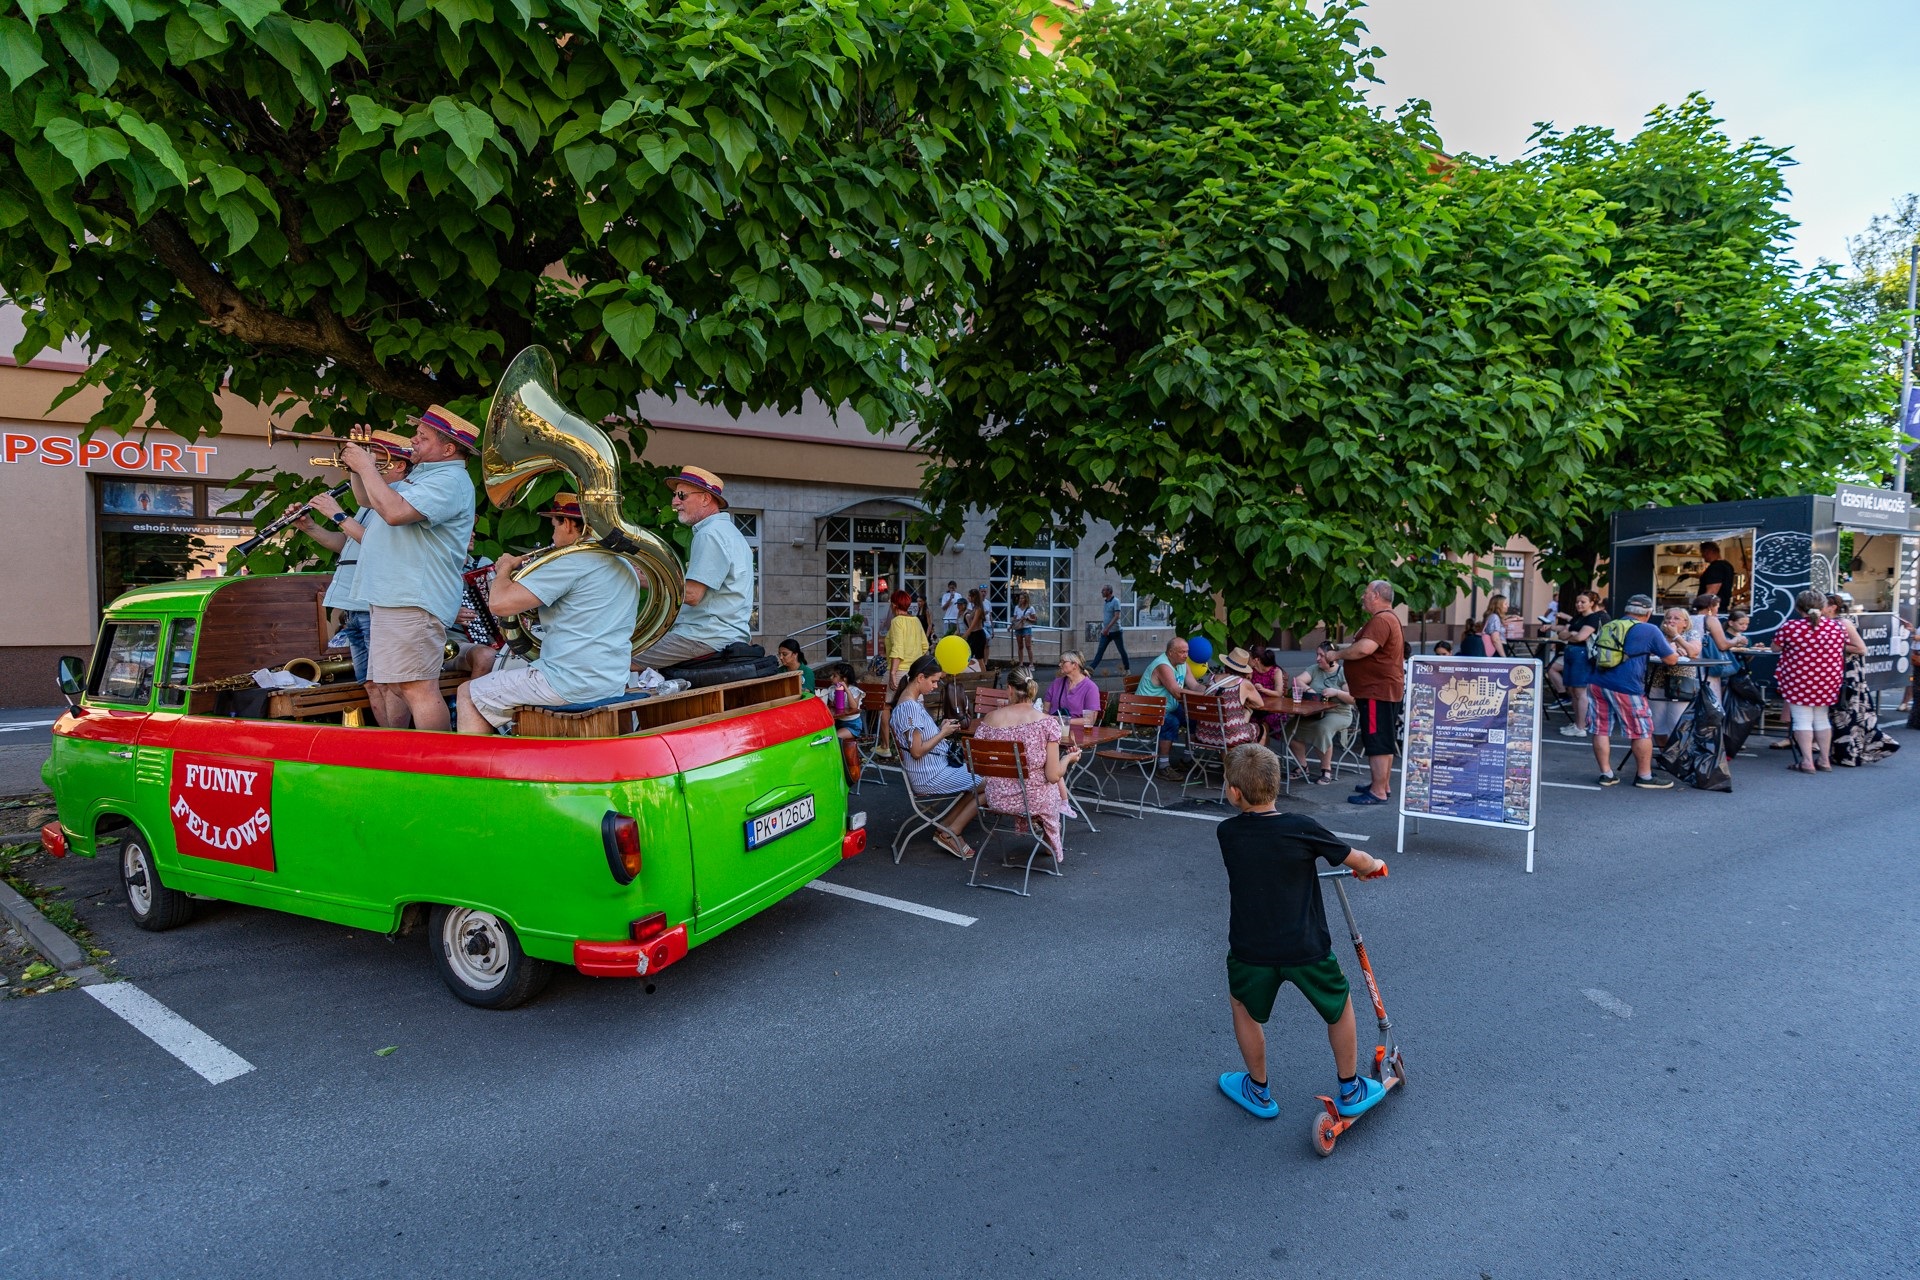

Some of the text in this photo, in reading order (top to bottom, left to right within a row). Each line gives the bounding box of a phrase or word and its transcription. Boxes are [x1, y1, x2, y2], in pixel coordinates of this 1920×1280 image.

[0, 433, 217, 474] PSPORT
[1841, 489, 1906, 514] ČERSTVÉ LANGOŠE
[133, 523, 256, 537] eshop: www.alpsport.s
[857, 524, 899, 534] LEKÁREŇ
[1862, 624, 1887, 640] LANGOŠ
[1867, 644, 1889, 656] OT-DOG
[1865, 660, 1893, 674] RANOLKY
[1453, 695, 1490, 710] Rande
[1456, 707, 1498, 717] mestom
[185, 764, 258, 795] FUNNY
[172, 794, 270, 850] FELLOWS
[755, 798, 813, 841] PK 126CX
